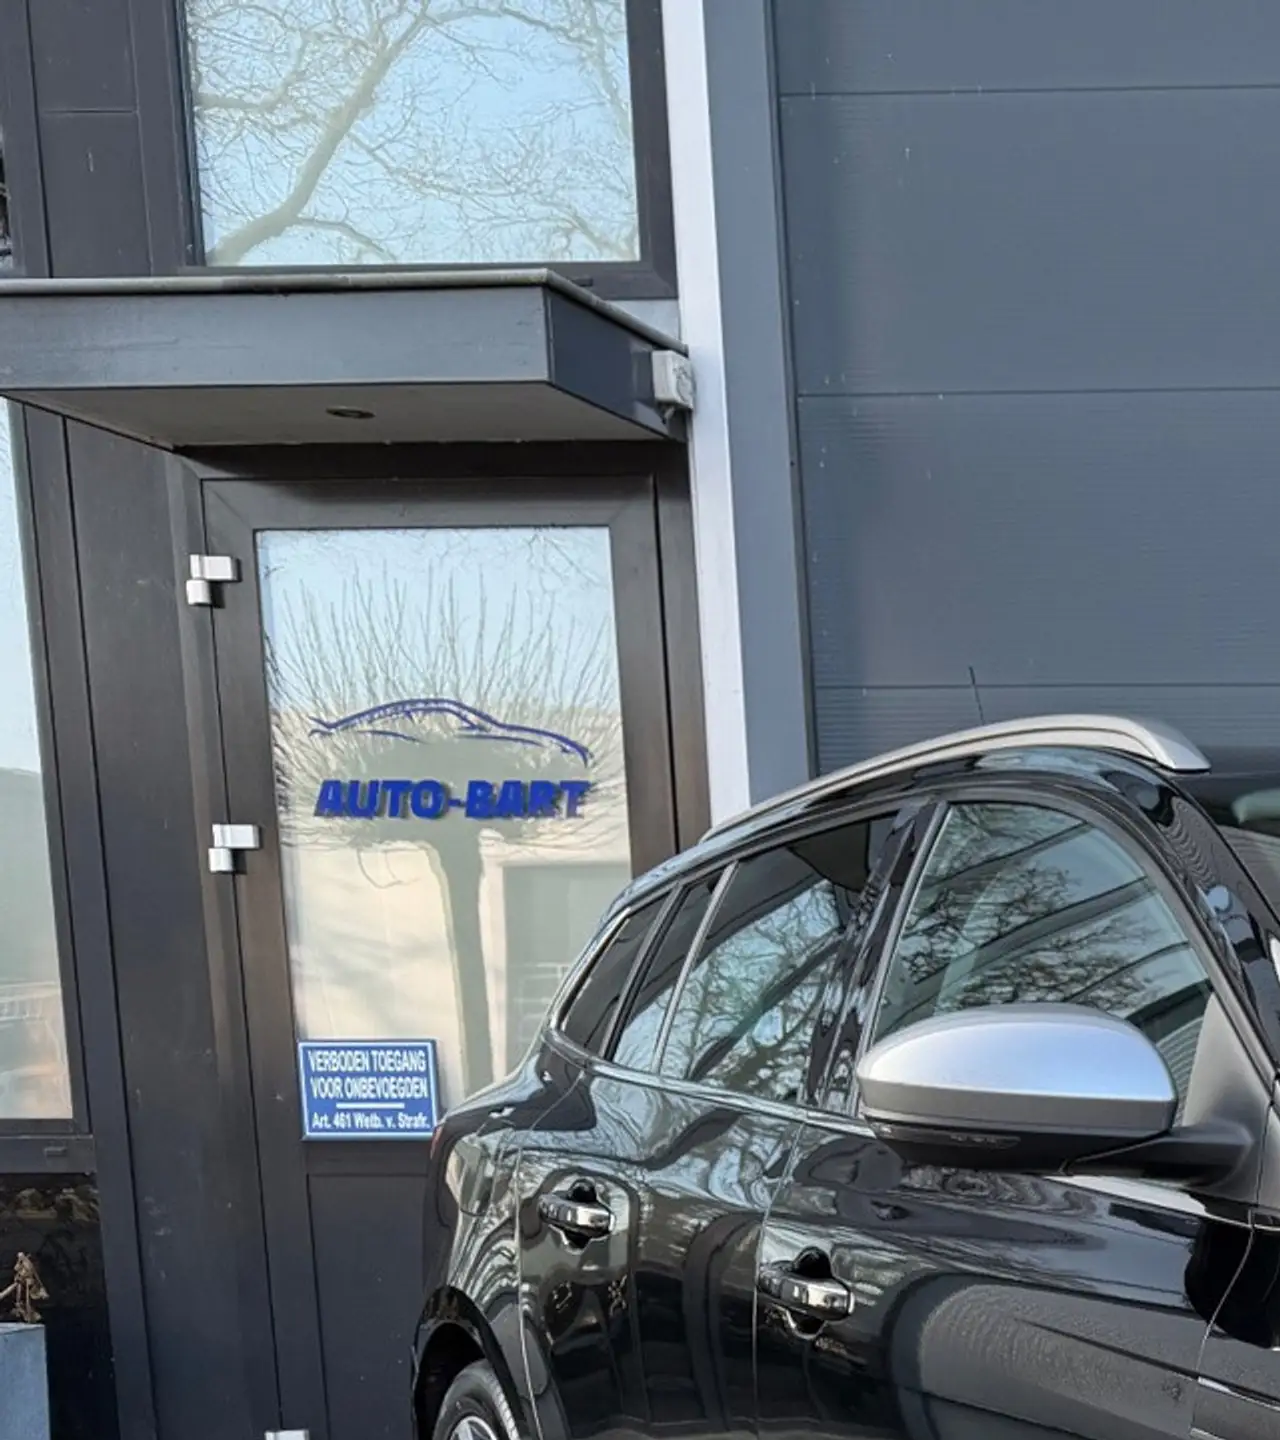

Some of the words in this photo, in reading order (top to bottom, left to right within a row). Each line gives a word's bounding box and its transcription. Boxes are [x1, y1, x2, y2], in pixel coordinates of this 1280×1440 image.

[313, 779, 592, 820] AUTO-BART
[308, 1050, 369, 1072] VERBODEN
[370, 1050, 426, 1072] TOEGANG
[310, 1076, 343, 1099] VOOR
[345, 1076, 428, 1099] ONBEVOEGDEN
[312, 1112, 331, 1128] Art.
[333, 1112, 351, 1128] 461
[353, 1112, 384, 1129] Wetb.
[386, 1116, 395, 1128] v.
[398, 1112, 430, 1129] Strafr.
